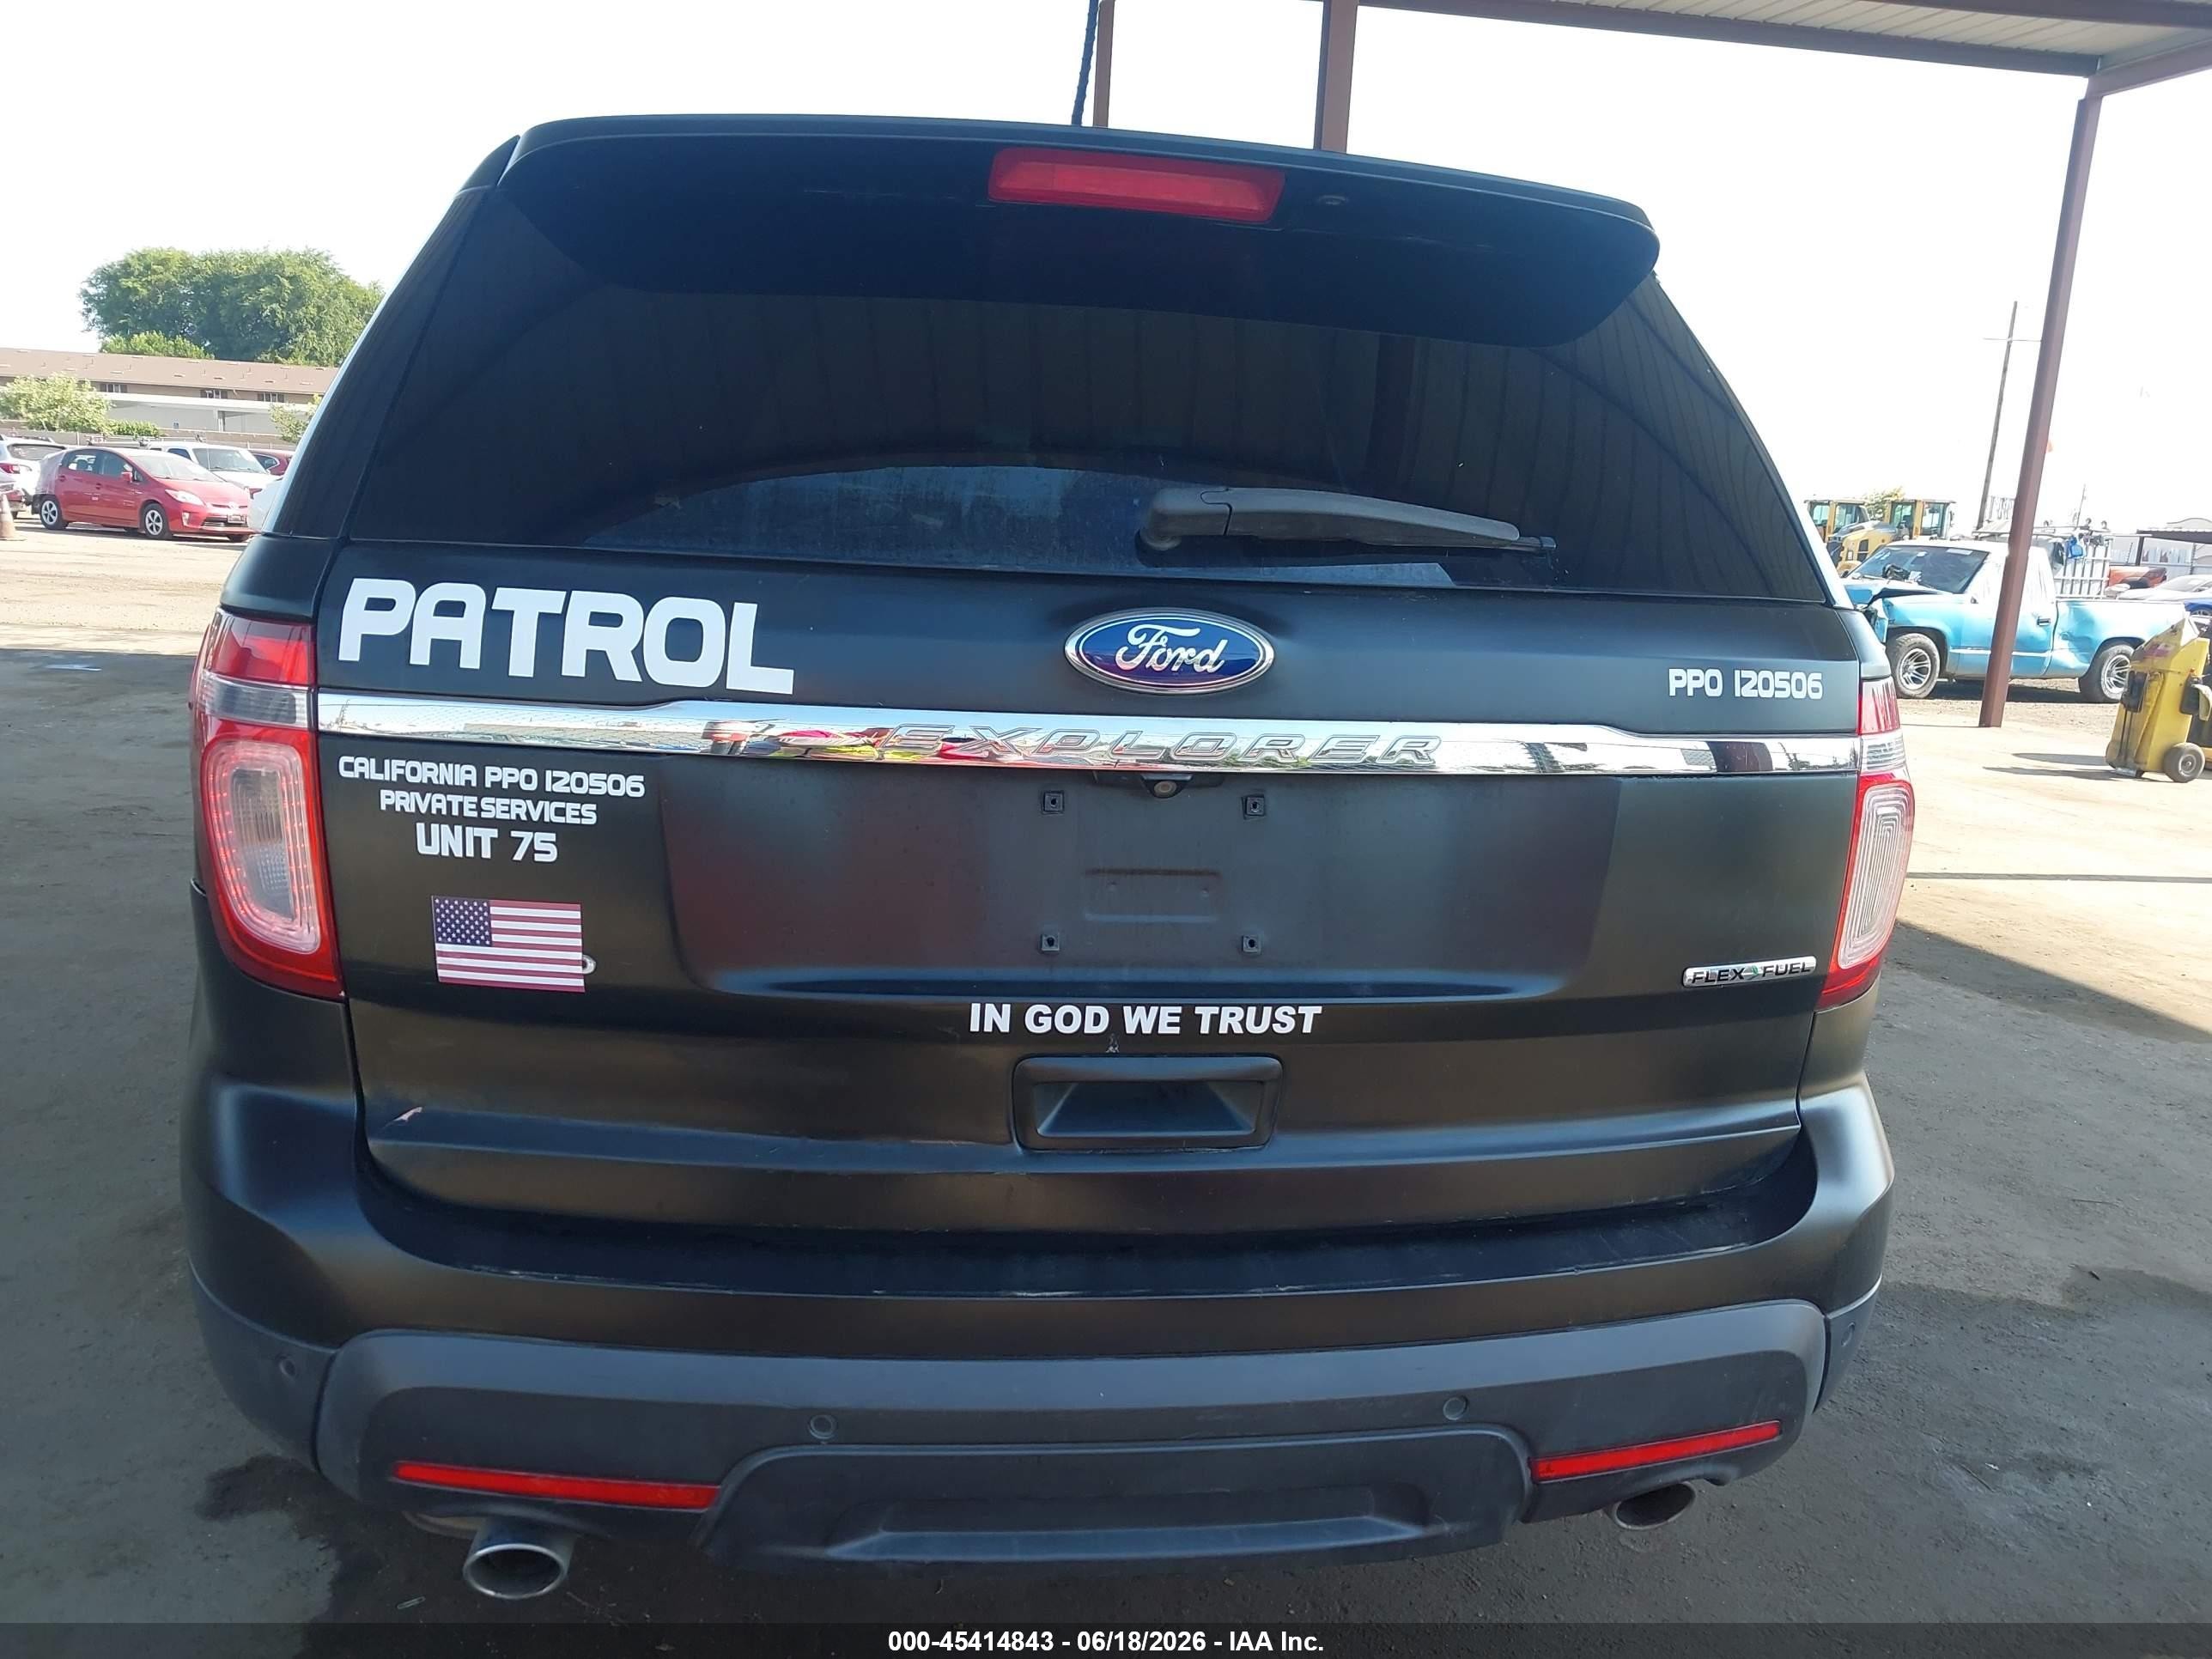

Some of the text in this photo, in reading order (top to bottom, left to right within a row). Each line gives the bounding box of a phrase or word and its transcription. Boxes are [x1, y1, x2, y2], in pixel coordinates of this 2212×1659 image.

[338, 577, 794, 695] PATROL
[1115, 623, 1228, 674] Ford
[1668, 668, 1823, 700] PPO 120506
[879, 724, 1443, 764] EXPLORER
[338, 756, 645, 798] CALIFORNIA PPO 120506
[380, 789, 597, 825] PRIVATE SERVICES
[416, 822, 558, 863] UNIT 75
[1692, 962, 1810, 984] FLEX FUEL
[970, 1003, 1322, 1034] IN GOD WE TRUST
